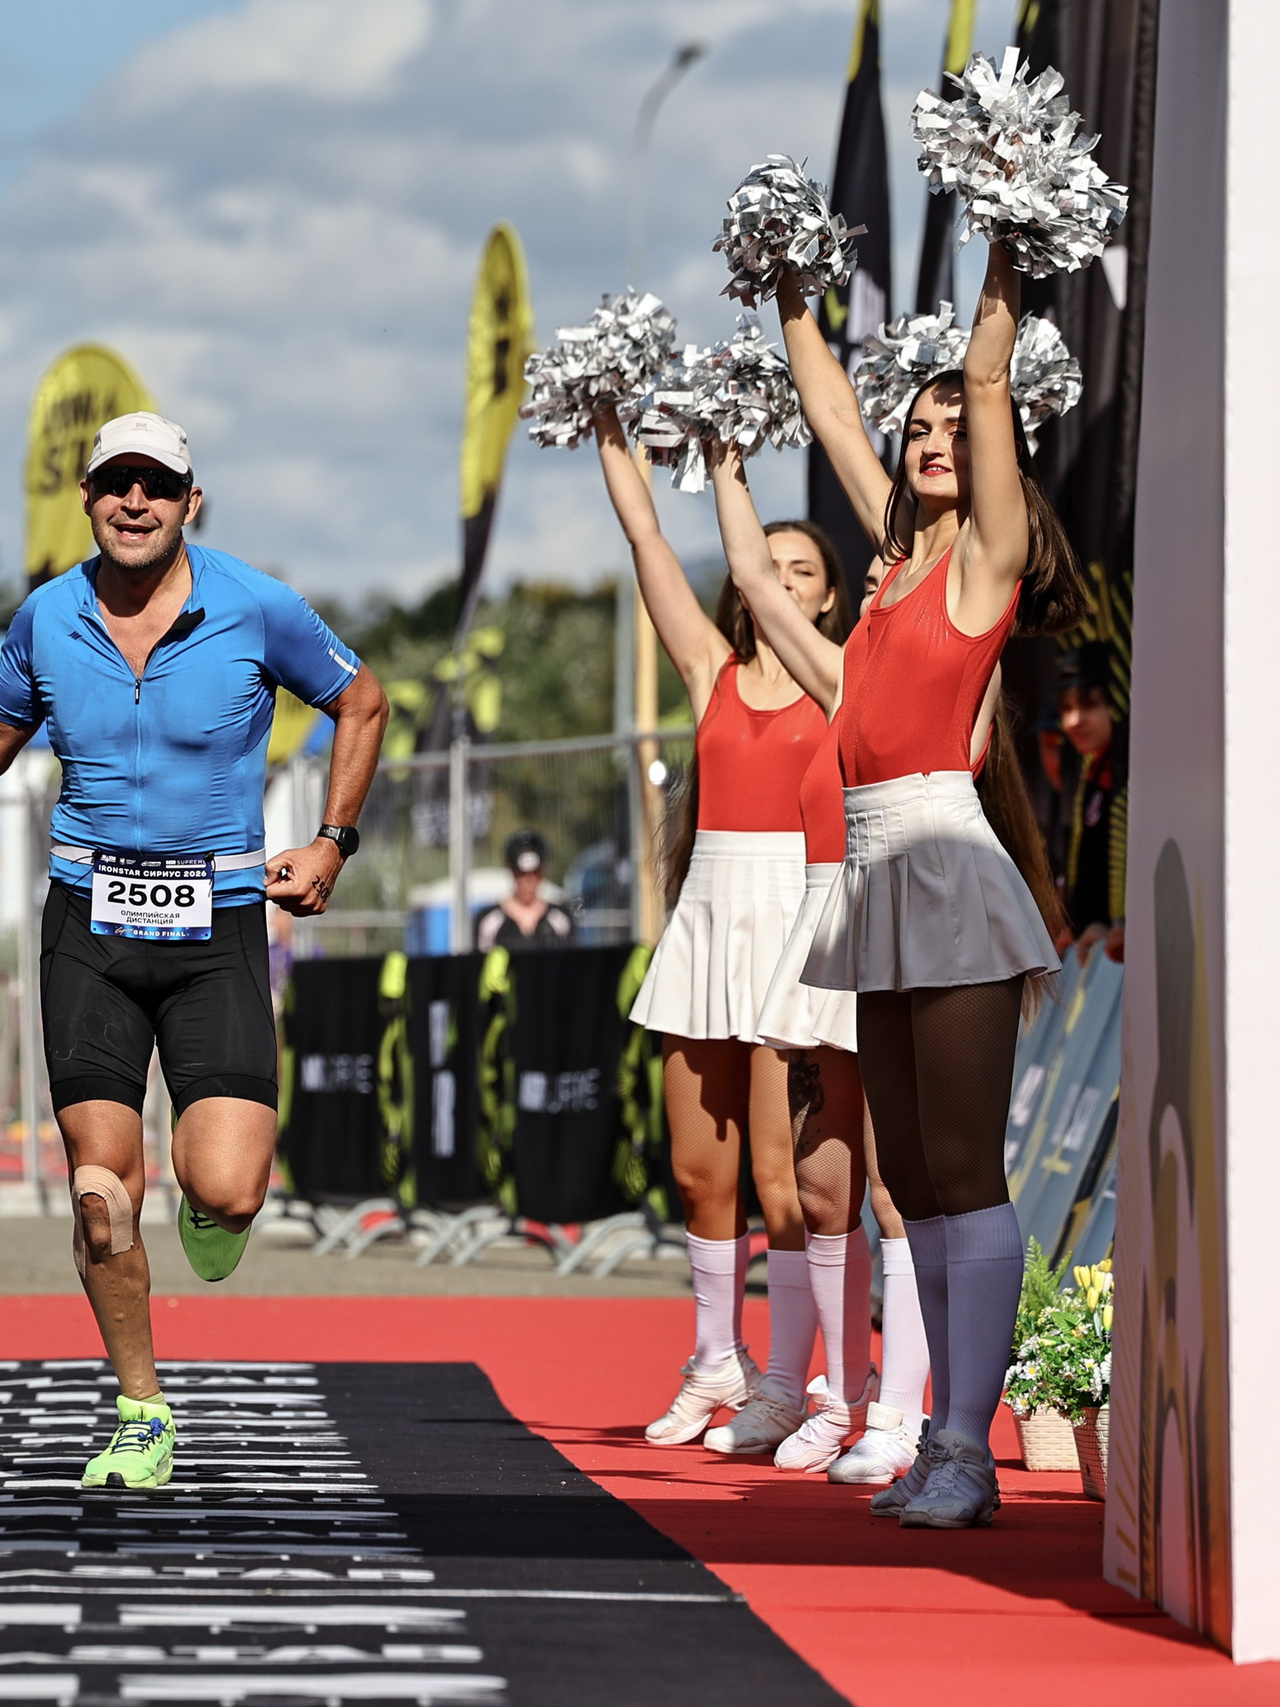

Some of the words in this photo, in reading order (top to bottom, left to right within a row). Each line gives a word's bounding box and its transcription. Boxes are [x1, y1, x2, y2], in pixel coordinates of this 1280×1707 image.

[98, 864, 140, 877] IRONSTAR
[143, 870, 182, 878] СИРИУС
[183, 870, 207, 878] 2026
[107, 880, 195, 908] 2508
[120, 909, 180, 918] ОЛИМПИЙСКАЯ
[126, 916, 174, 925] ДИСТАНЦИЯ
[133, 929, 160, 937] GRAND
